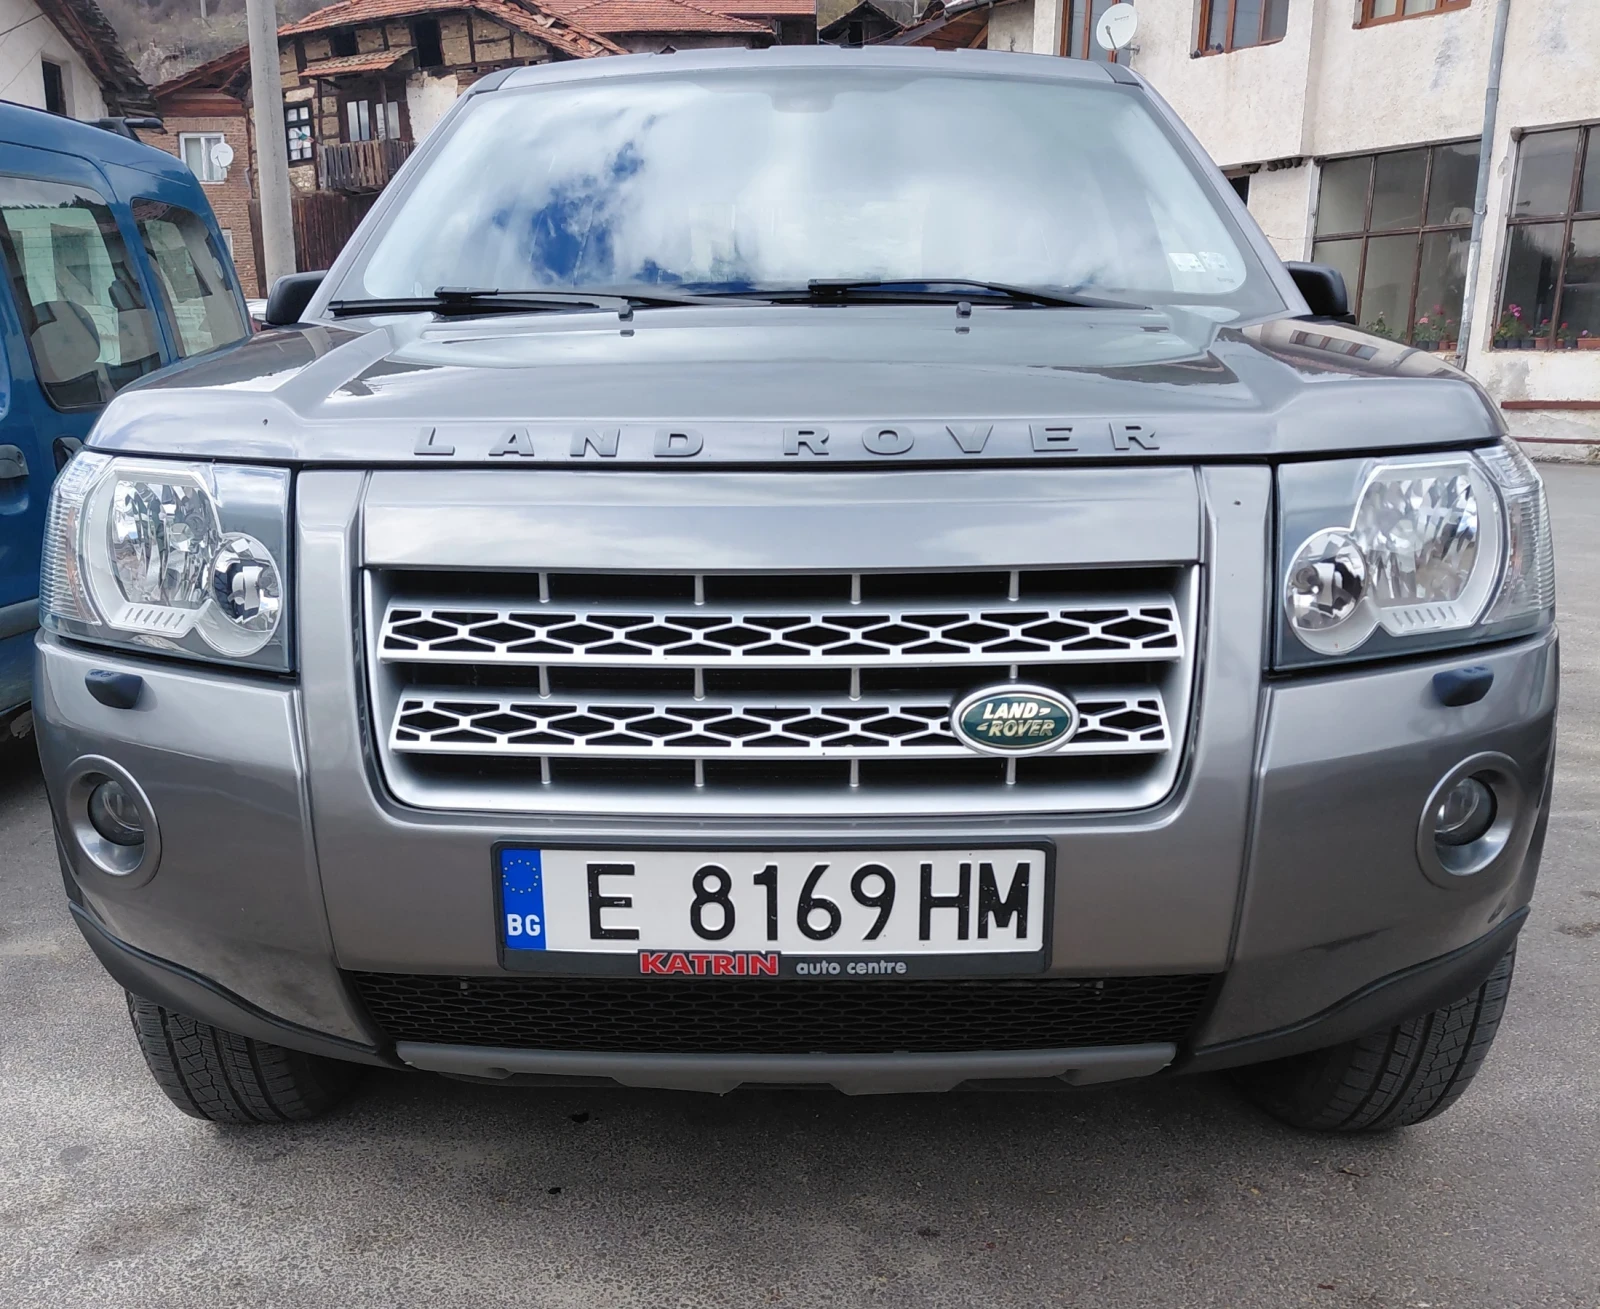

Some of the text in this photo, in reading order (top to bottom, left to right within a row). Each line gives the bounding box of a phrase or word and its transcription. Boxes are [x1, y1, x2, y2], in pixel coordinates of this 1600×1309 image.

[413, 421, 1161, 457] LAND ROVER
[586, 862, 640, 941] E
[506, 913, 541, 937] BG
[639, 952, 907, 976] KATRIN auto centre
